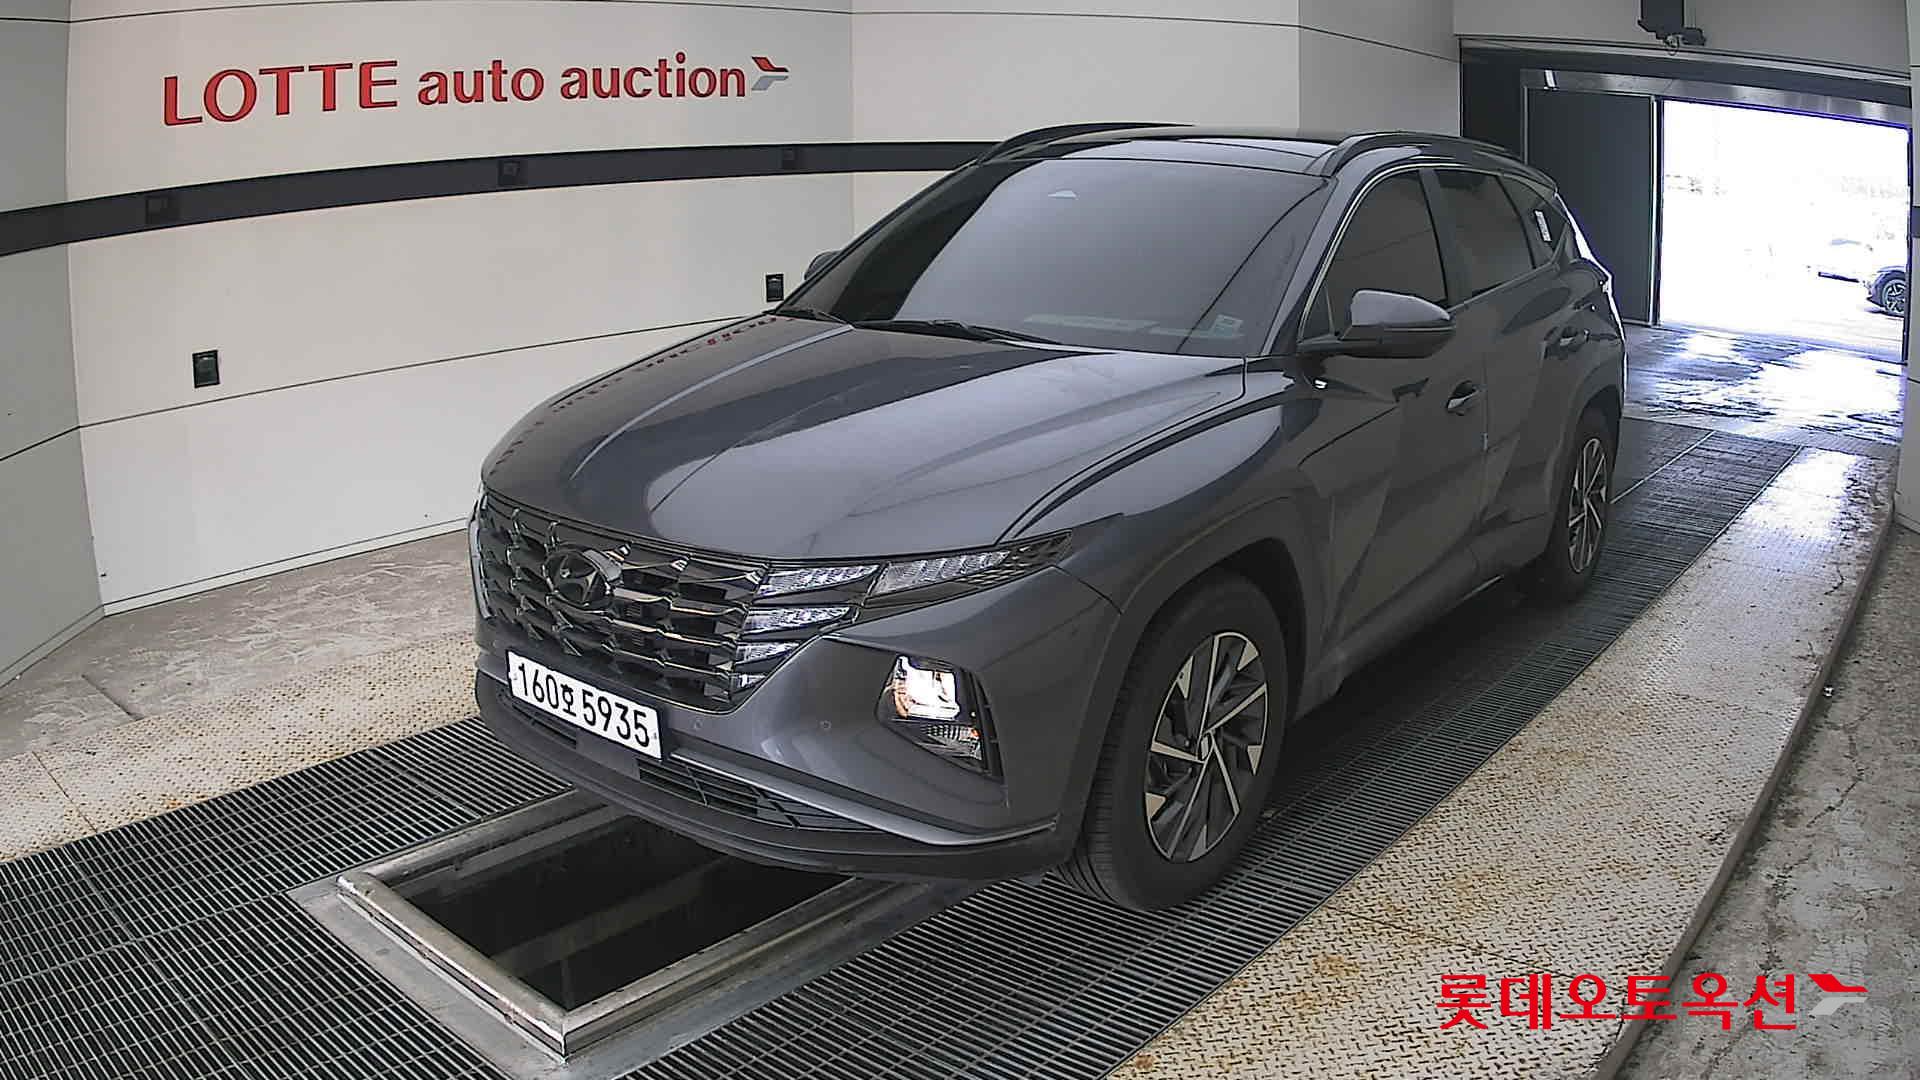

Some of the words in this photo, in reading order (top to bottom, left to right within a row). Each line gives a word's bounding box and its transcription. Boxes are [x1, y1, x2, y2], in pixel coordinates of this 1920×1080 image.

[163, 60, 398, 126] LOTTE
[417, 59, 544, 105] auto
[560, 52, 747, 99] auction
